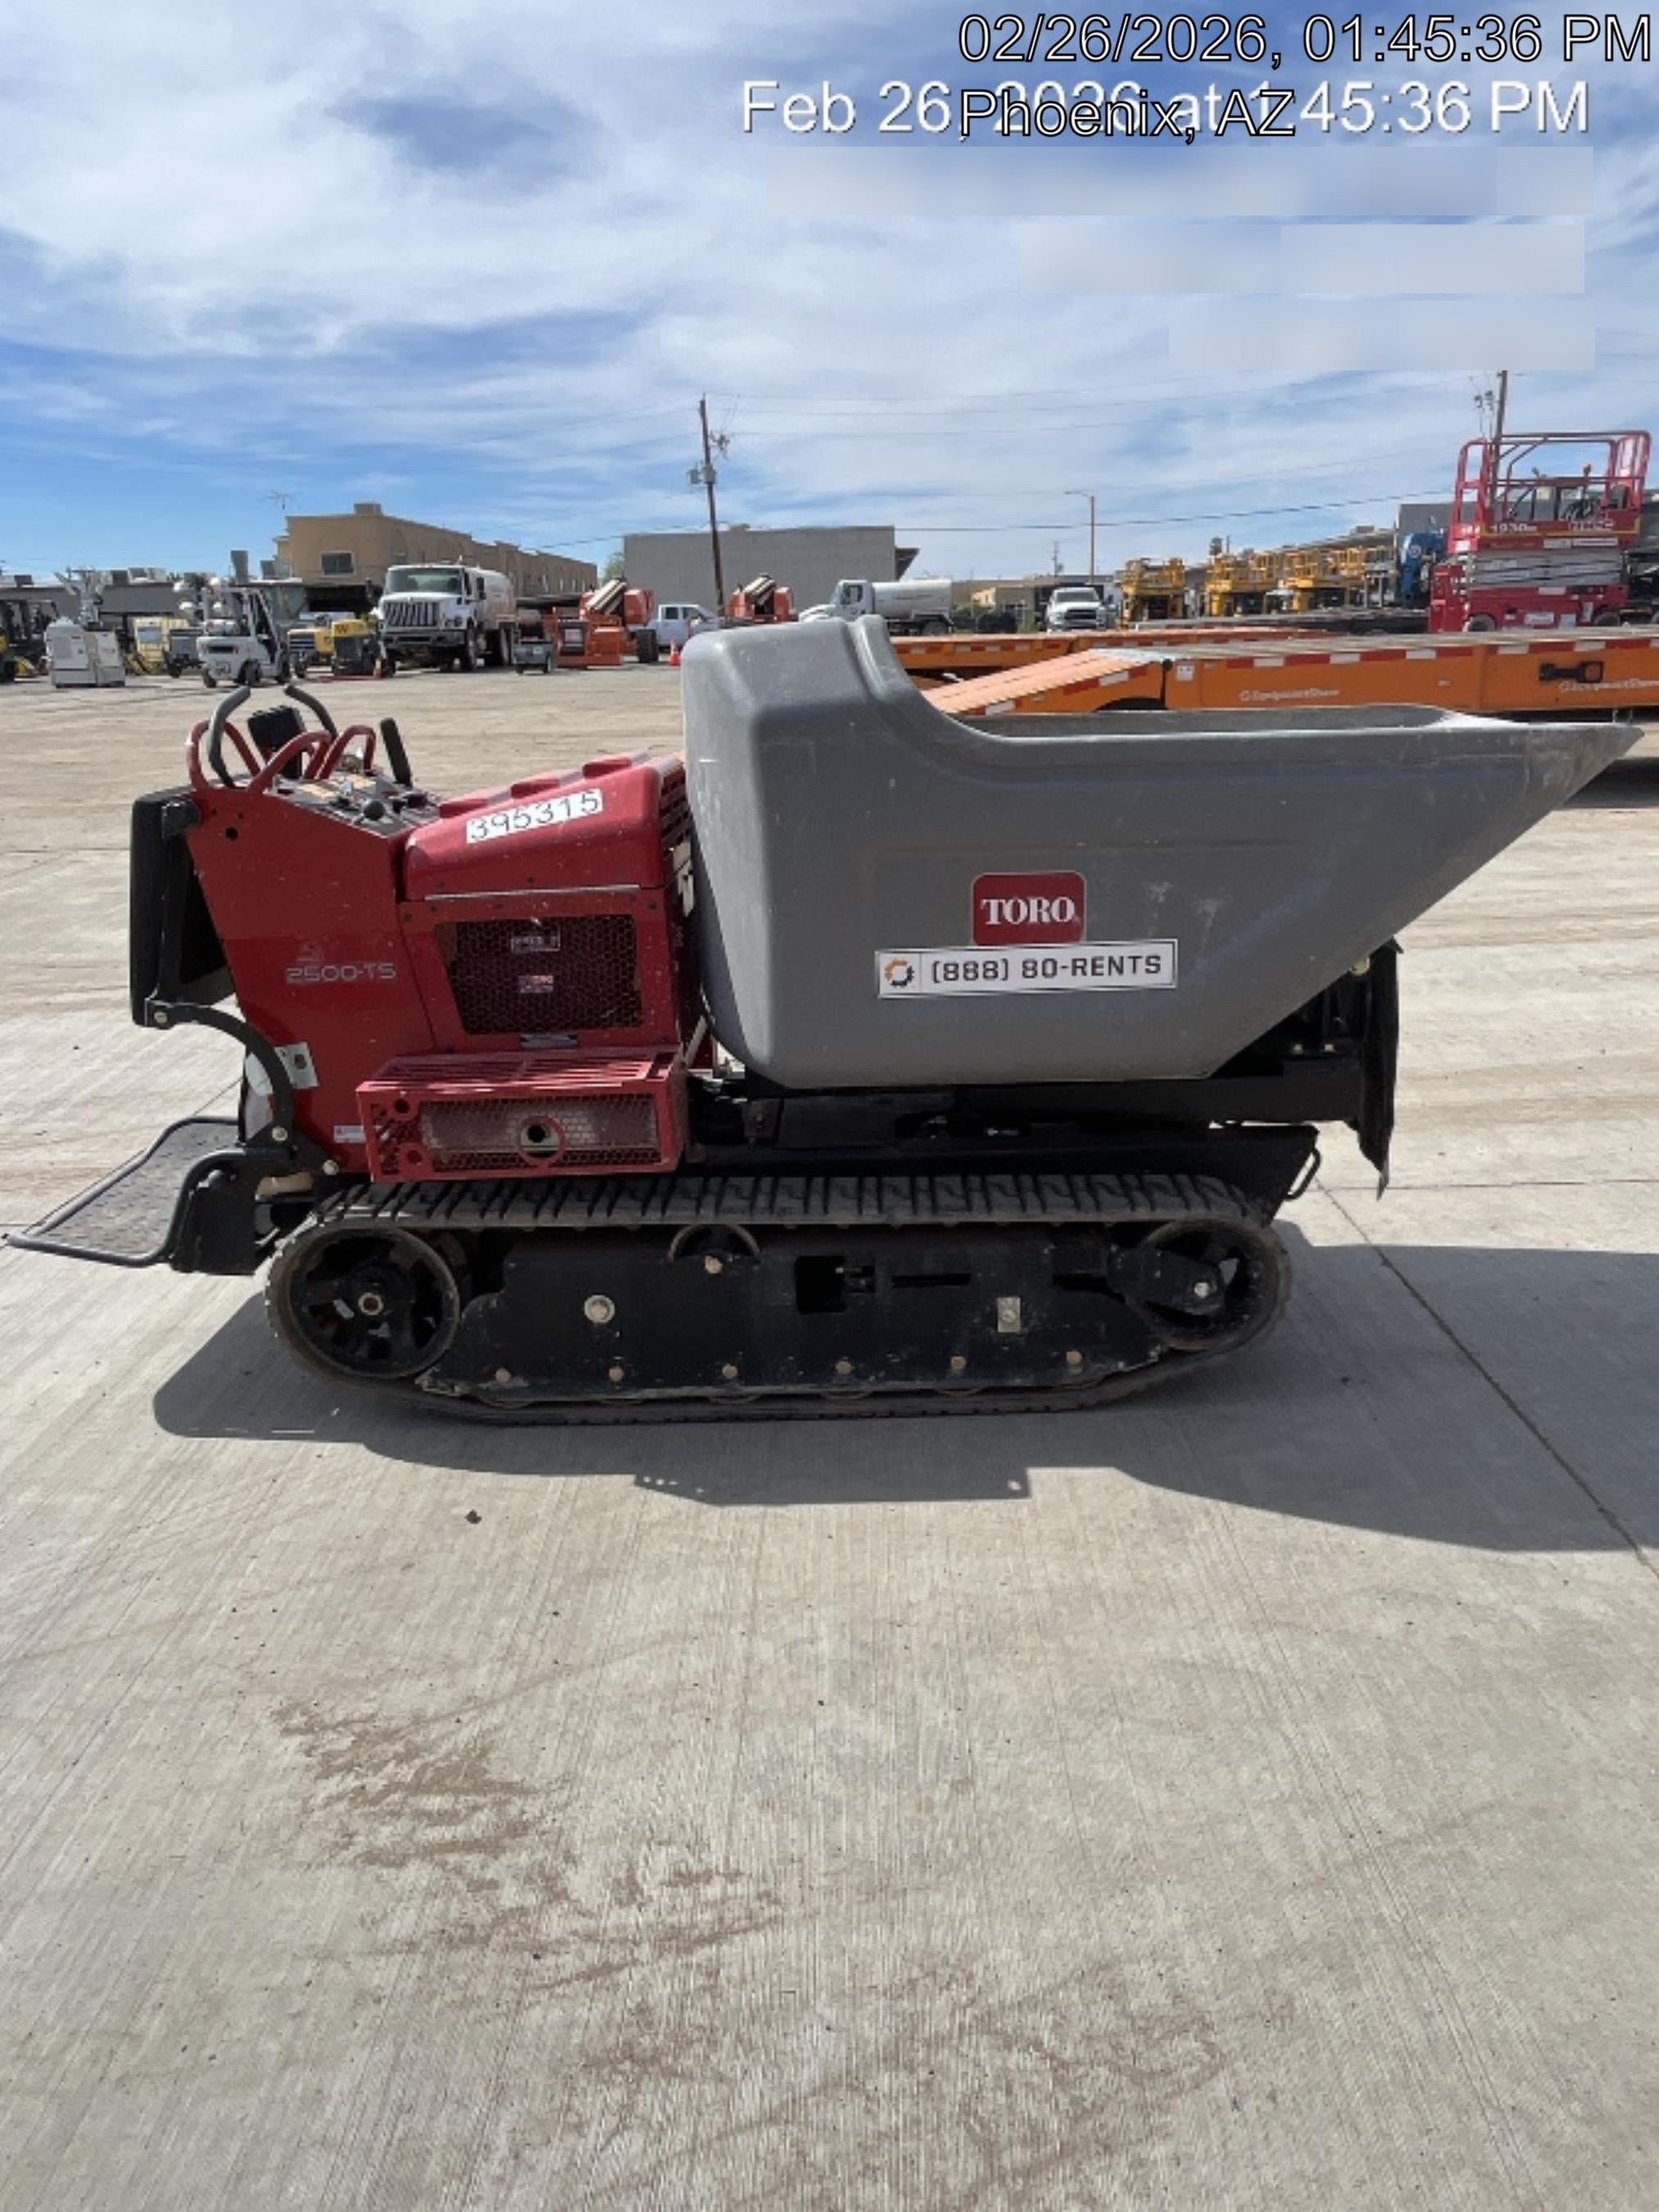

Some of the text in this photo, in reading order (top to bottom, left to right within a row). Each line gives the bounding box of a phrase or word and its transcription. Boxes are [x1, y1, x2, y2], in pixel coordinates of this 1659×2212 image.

[470, 791, 600, 840] 395315
[980, 895, 1076, 926] TORO
[286, 962, 397, 984] 2500-TS
[1022, 954, 1162, 979] 80-RENTS
